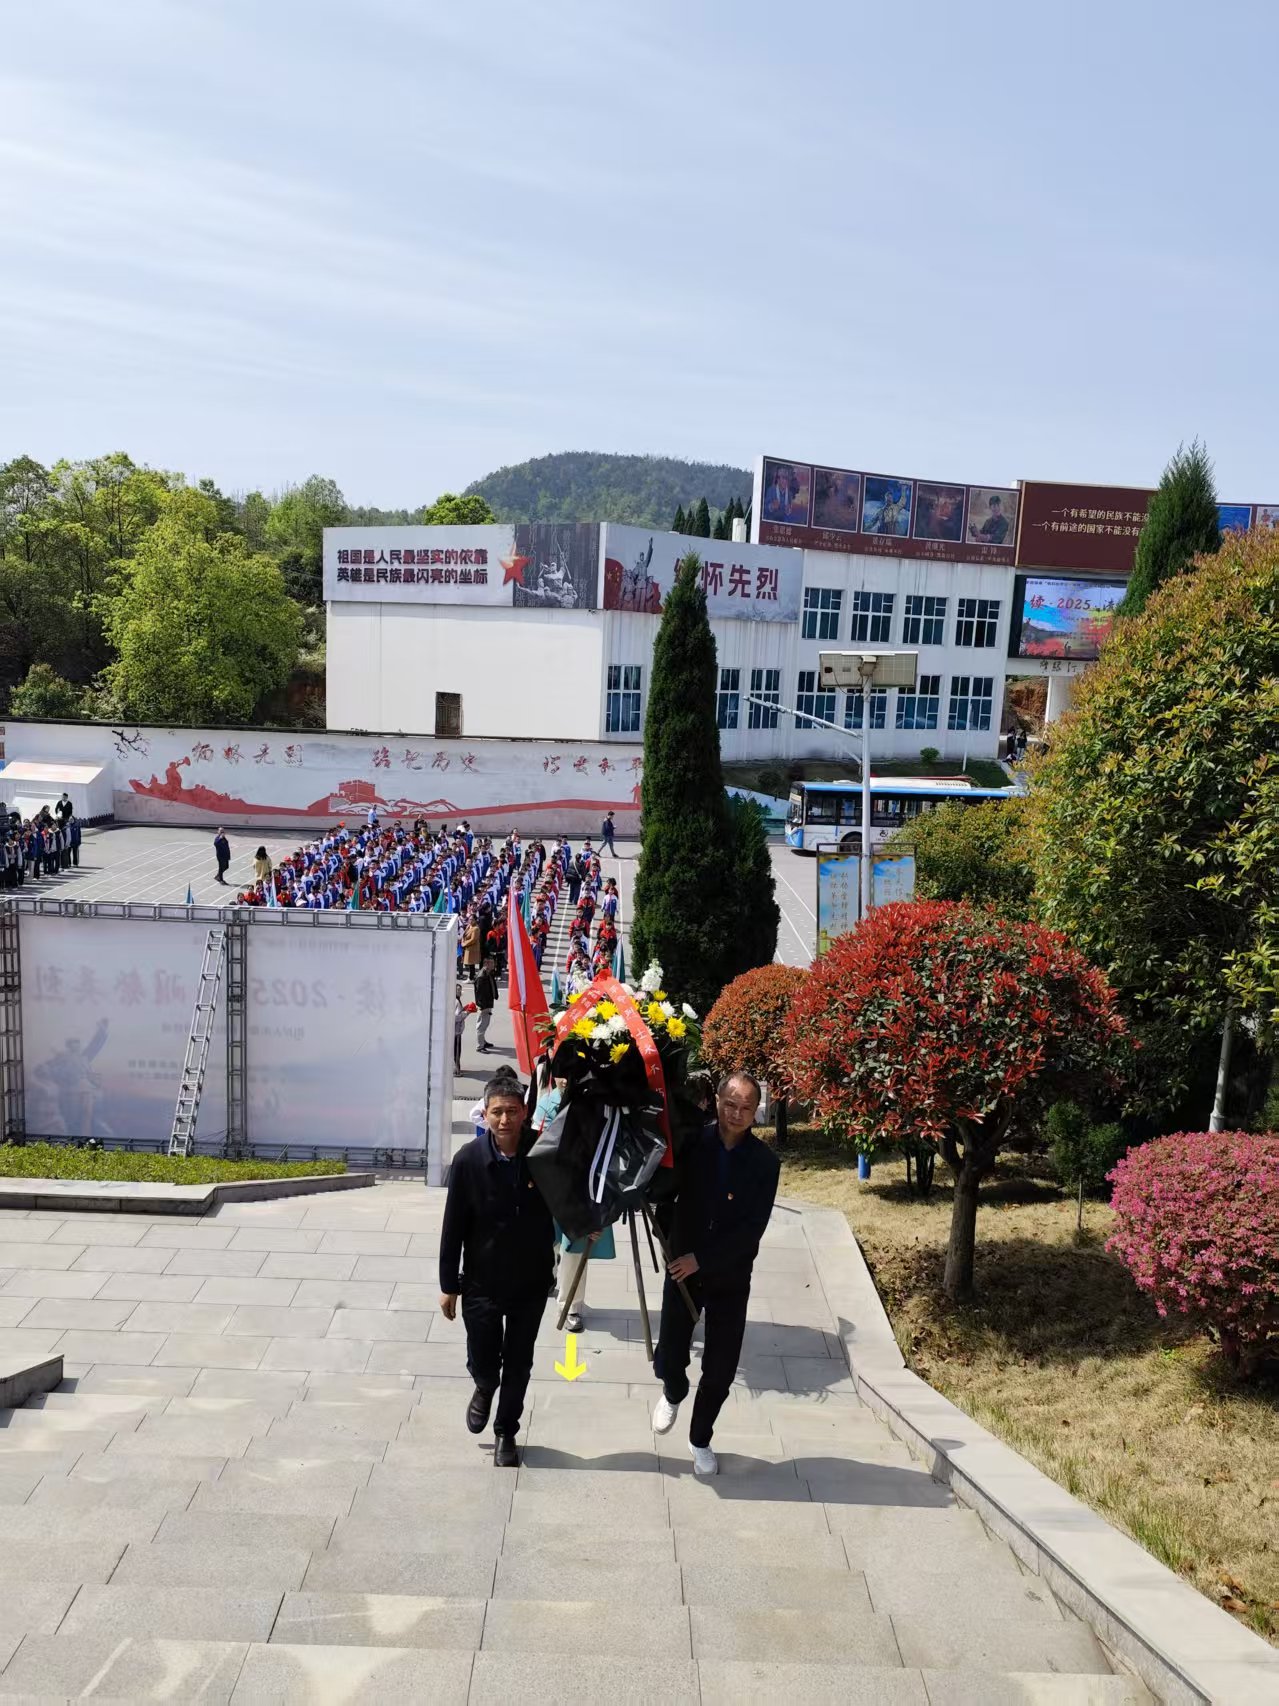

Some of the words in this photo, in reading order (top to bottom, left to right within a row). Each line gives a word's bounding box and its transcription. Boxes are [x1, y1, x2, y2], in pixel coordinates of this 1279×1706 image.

[337, 549, 488, 565] 祖国是人民最坚实的依靠
[337, 567, 488, 584] 英雄是民族最闪亮的坐标
